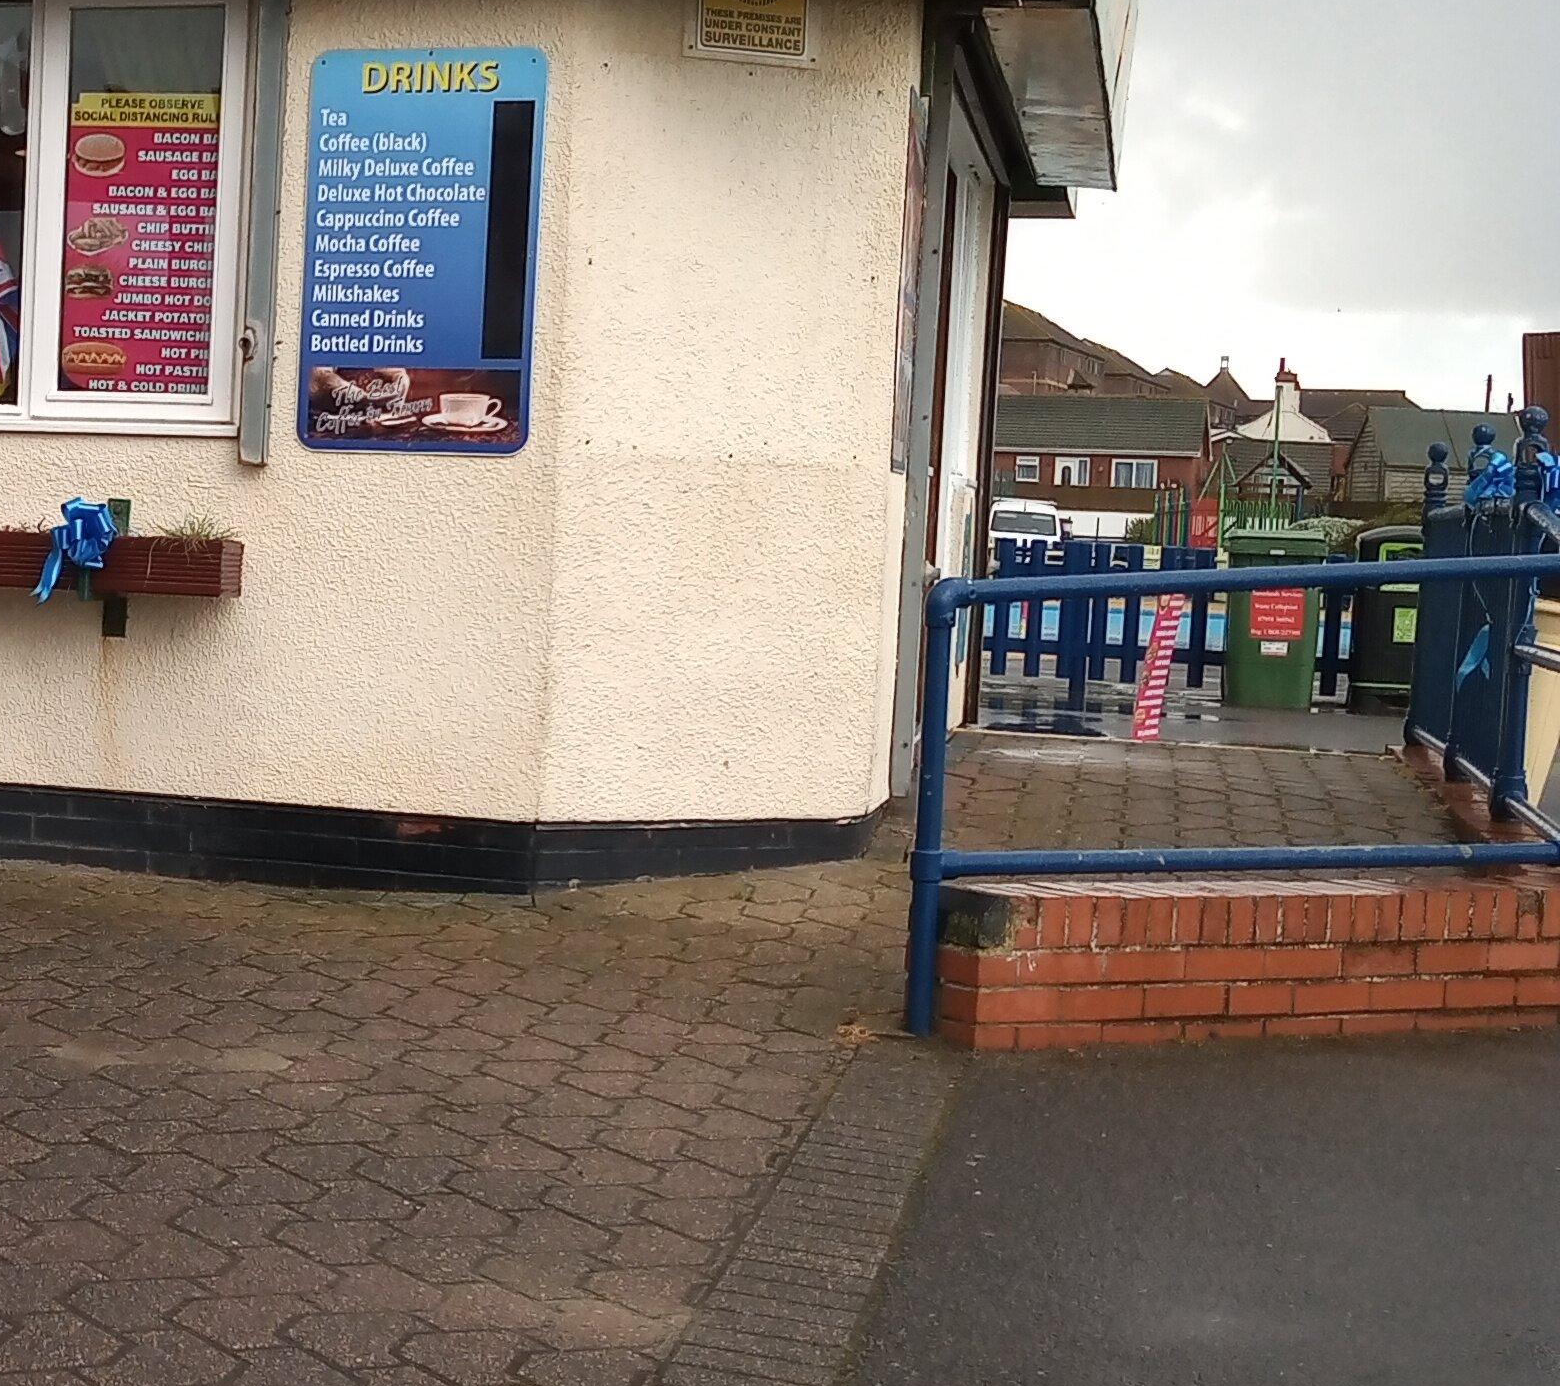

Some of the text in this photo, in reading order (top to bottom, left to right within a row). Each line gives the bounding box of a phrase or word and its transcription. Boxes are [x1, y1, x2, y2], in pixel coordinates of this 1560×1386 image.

[706, 8, 801, 25] THESE PREMISES ARE
[705, 18, 802, 37] UNDER CONSTANT
[705, 31, 801, 51] SURVEILLANCE
[362, 61, 500, 94] DRINKS
[101, 98, 204, 109] PLEASE OBSERVE
[74, 111, 116, 122] SOCIAL
[119, 112, 189, 122] DISTANCING
[320, 109, 347, 126] Tea
[154, 133, 200, 144] BACON
[319, 133, 427, 153] Coffee (black)
[138, 151, 199, 162] SAUSAGE
[171, 169, 198, 180] EGG
[318, 158, 474, 180] Milky Deluxe Coffee
[108, 186, 154, 197] BACON
[157, 187, 168, 197] &
[171, 187, 198, 198] EGG
[317, 183, 486, 202] Deluxe Hot Chocolate
[92, 204, 154, 215] SAUSAGE
[157, 205, 167, 216] &
[170, 205, 197, 217] EGG
[317, 209, 460, 230] Cappuccino Coffee
[138, 222, 169, 233] CHIP
[131, 240, 182, 252] CHEESY
[315, 234, 420, 252] Mocha Coffee
[129, 257, 168, 269] PLAIN
[314, 260, 435, 280] Espresso Coffee
[119, 275, 168, 287] CHEESE
[114, 293, 162, 304] JUMBO
[164, 294, 191, 305] HOT
[313, 285, 400, 302] Milkshakes
[101, 310, 152, 321] JACKET
[312, 310, 424, 328] Canned Drinks
[73, 326, 131, 338] TOASTED
[311, 335, 424, 353] Bottled Drinks
[161, 347, 188, 359] HOT
[135, 364, 163, 375] HOT
[89, 379, 114, 390] HOT
[117, 380, 128, 391] &
[130, 381, 165, 392] COLD
[332, 376, 403, 406] The Best
[314, 404, 364, 434] Coffee
[386, 398, 433, 416] Town
